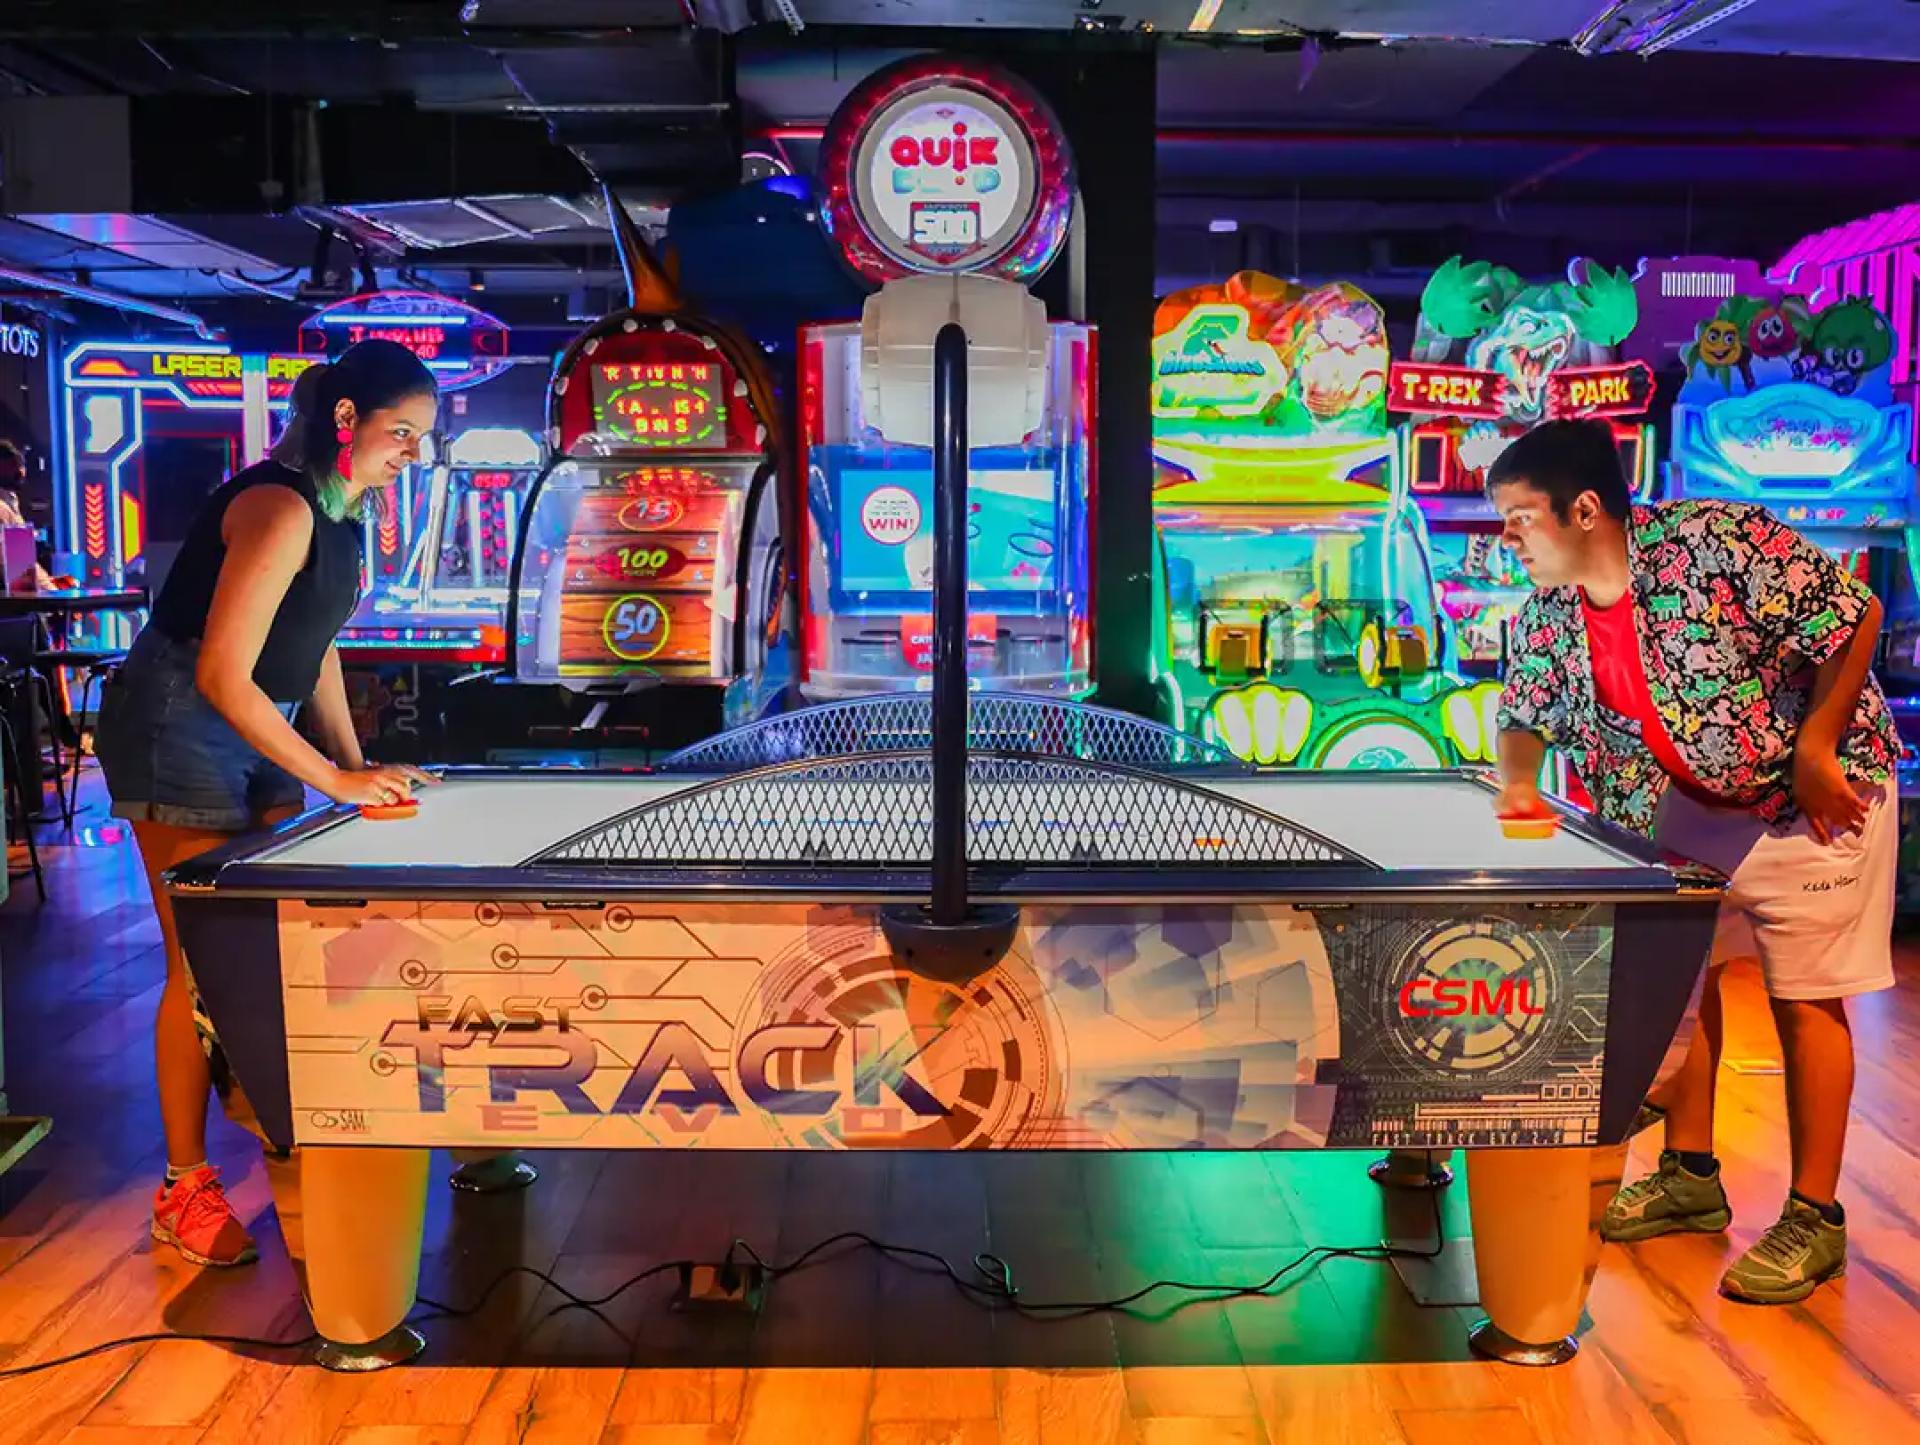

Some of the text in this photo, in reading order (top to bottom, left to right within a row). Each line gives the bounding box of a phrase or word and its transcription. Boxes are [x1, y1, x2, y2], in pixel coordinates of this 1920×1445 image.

[152, 354, 242, 378] LASER
[1401, 373, 1631, 406] T-REX PARK
[868, 518, 915, 531] WIN!
[617, 548, 669, 569] 100
[614, 602, 657, 641] 50
[1399, 978, 1545, 1018] CSML
[416, 995, 583, 1032] FAST
[380, 1020, 955, 1116] TRACK
[340, 1109, 366, 1131] SAM
[1372, 1133, 1411, 1146] FAST
[1426, 1133, 1476, 1145] TRACK
